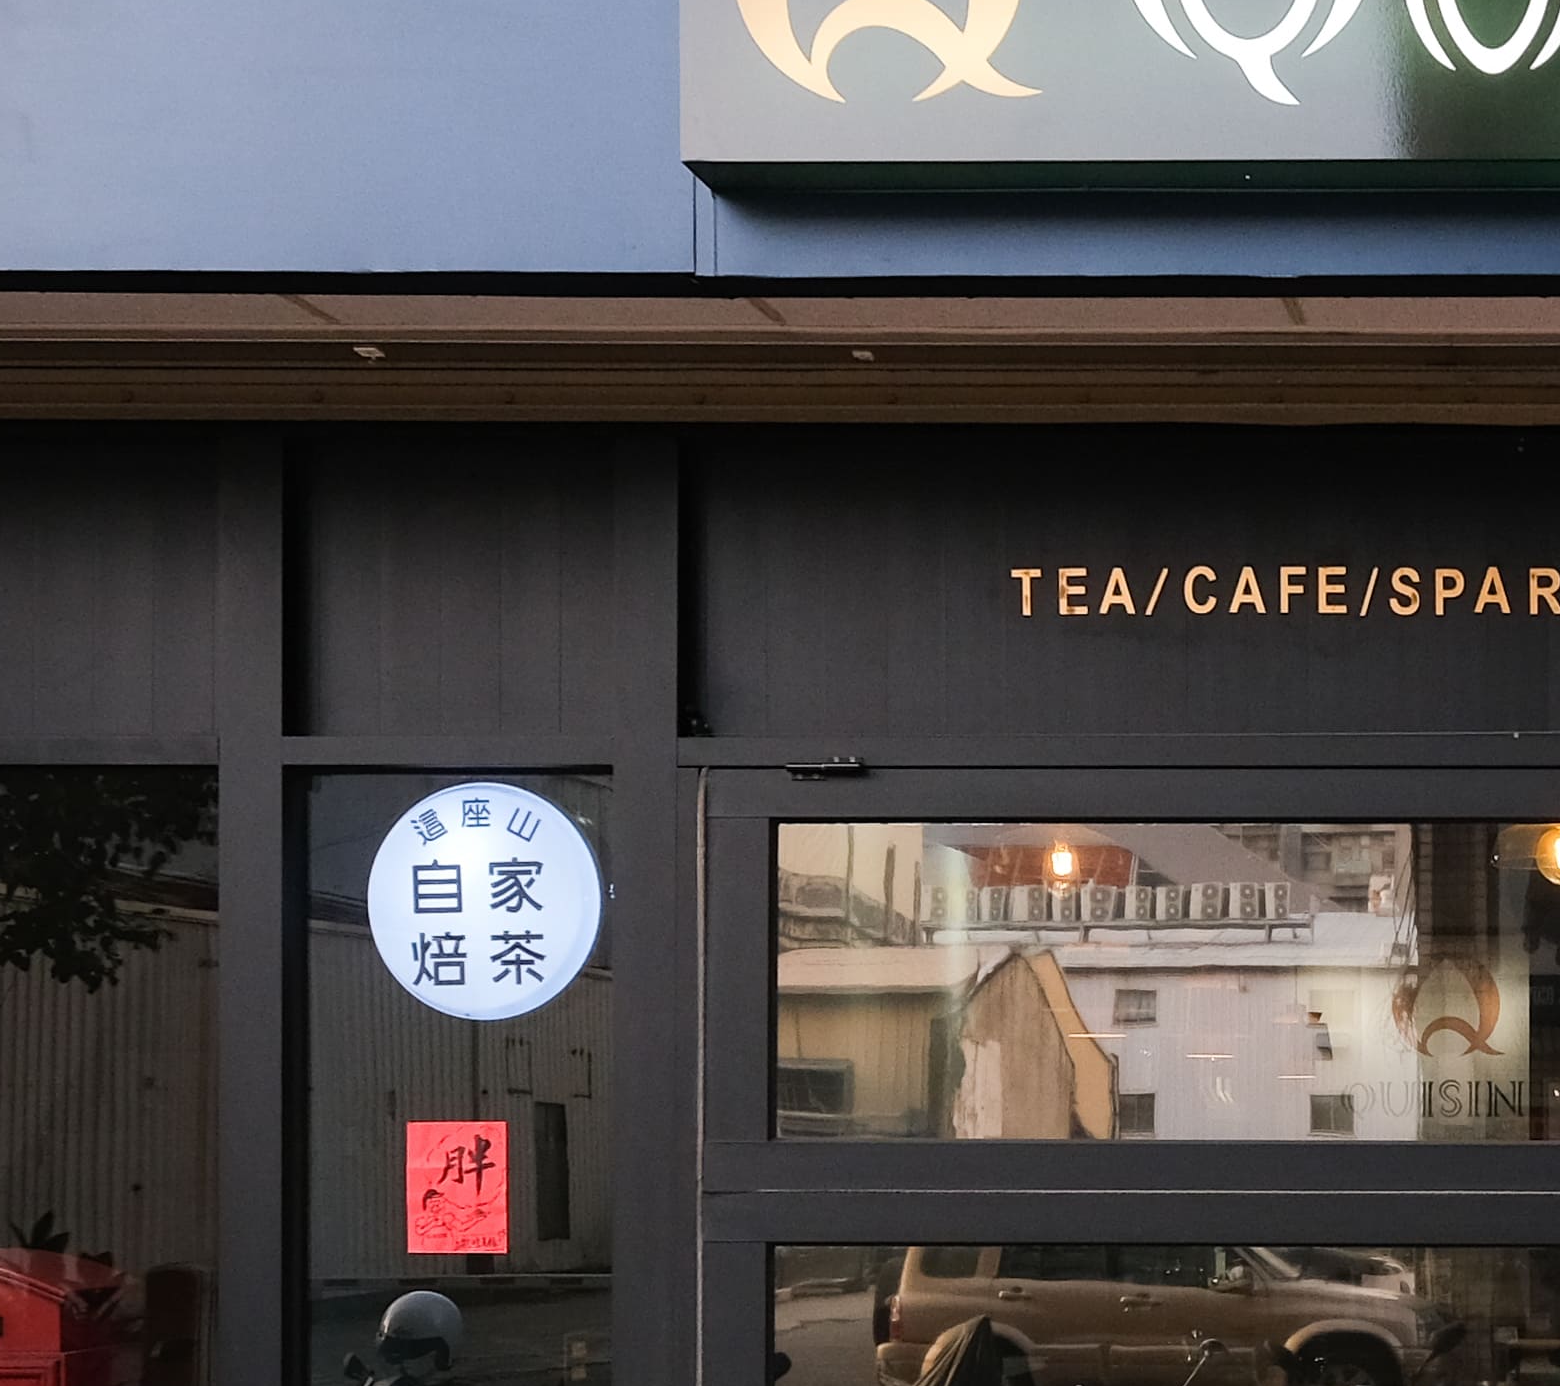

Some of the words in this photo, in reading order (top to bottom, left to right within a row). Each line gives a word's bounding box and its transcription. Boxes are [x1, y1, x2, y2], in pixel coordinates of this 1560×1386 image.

[410, 797, 543, 845] 這座山
[411, 857, 544, 915] 自家
[410, 930, 547, 986] 焙茶
[1341, 1079, 1524, 1119] QUISIN
[437, 1134, 496, 1196] 胖
